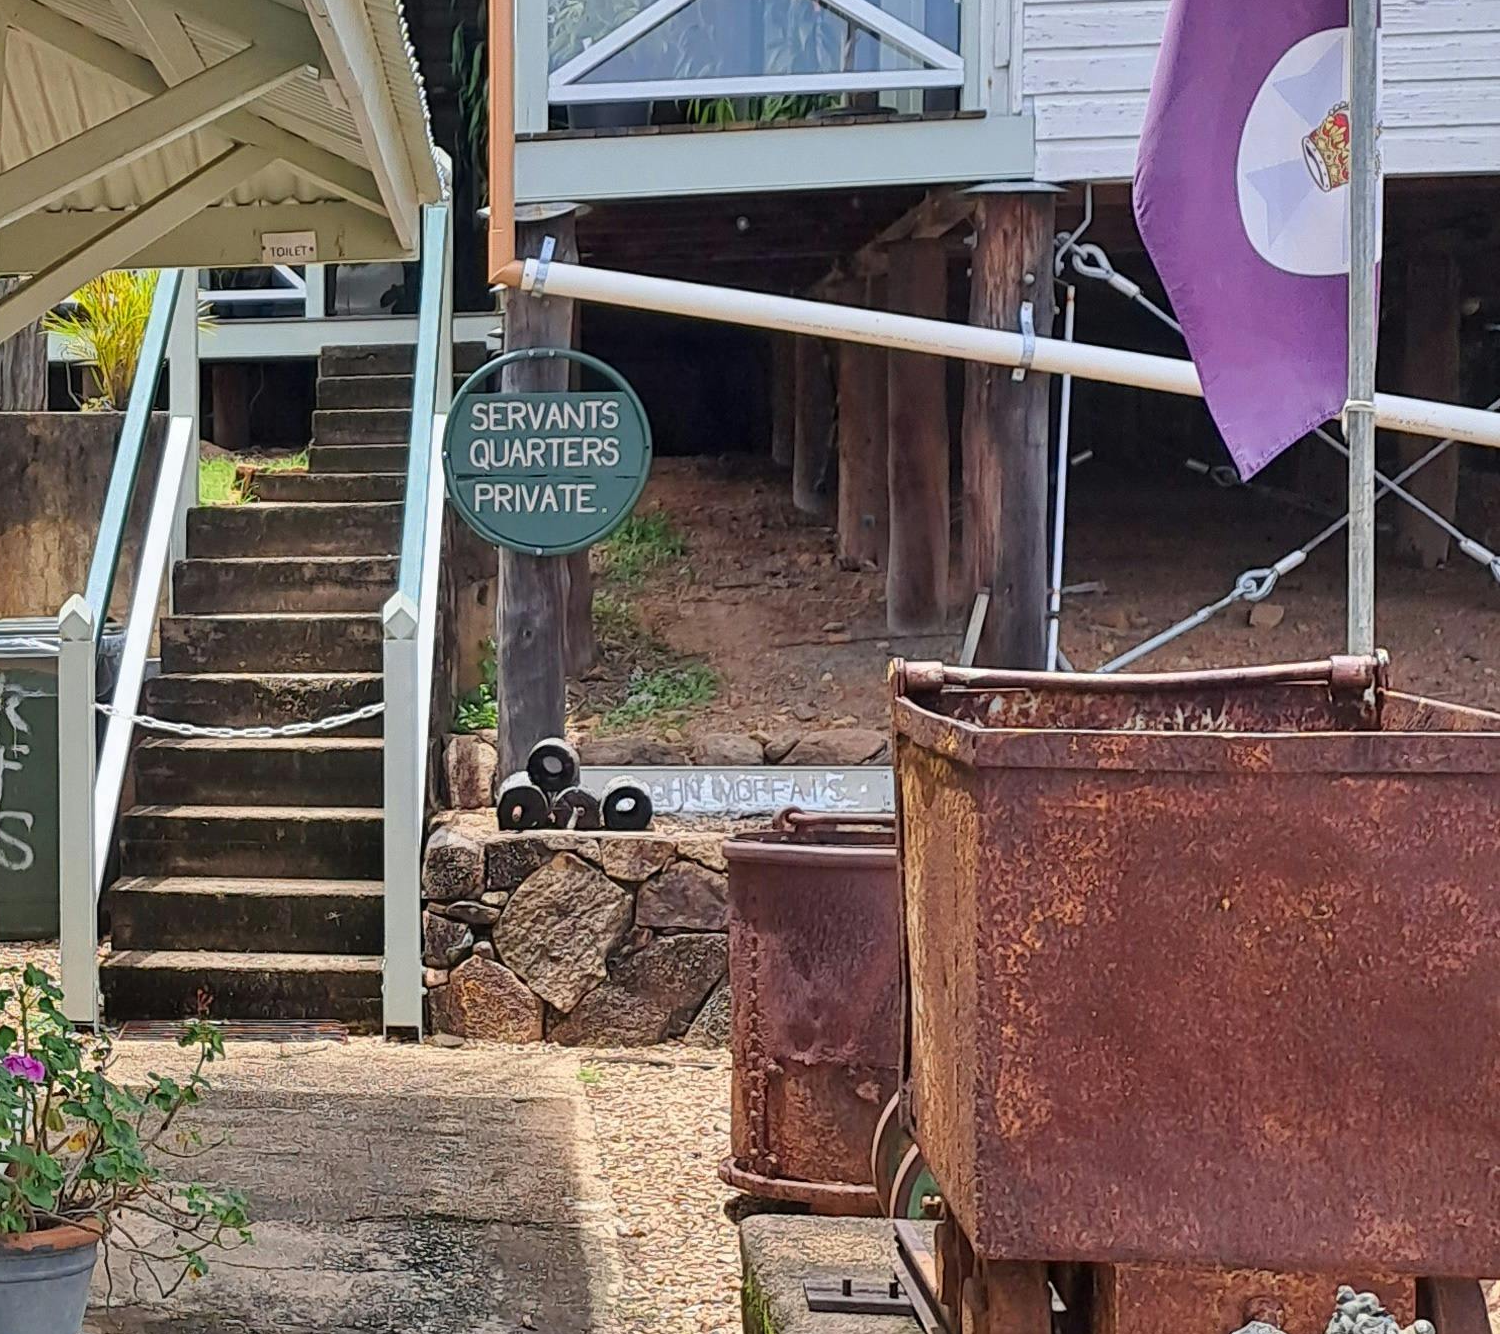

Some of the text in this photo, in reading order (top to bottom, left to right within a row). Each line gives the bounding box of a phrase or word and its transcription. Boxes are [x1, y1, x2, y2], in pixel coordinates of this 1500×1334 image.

[270, 245, 308, 258] TOILET
[470, 400, 620, 432] SERVANTS
[470, 437, 620, 471] QUARTERS
